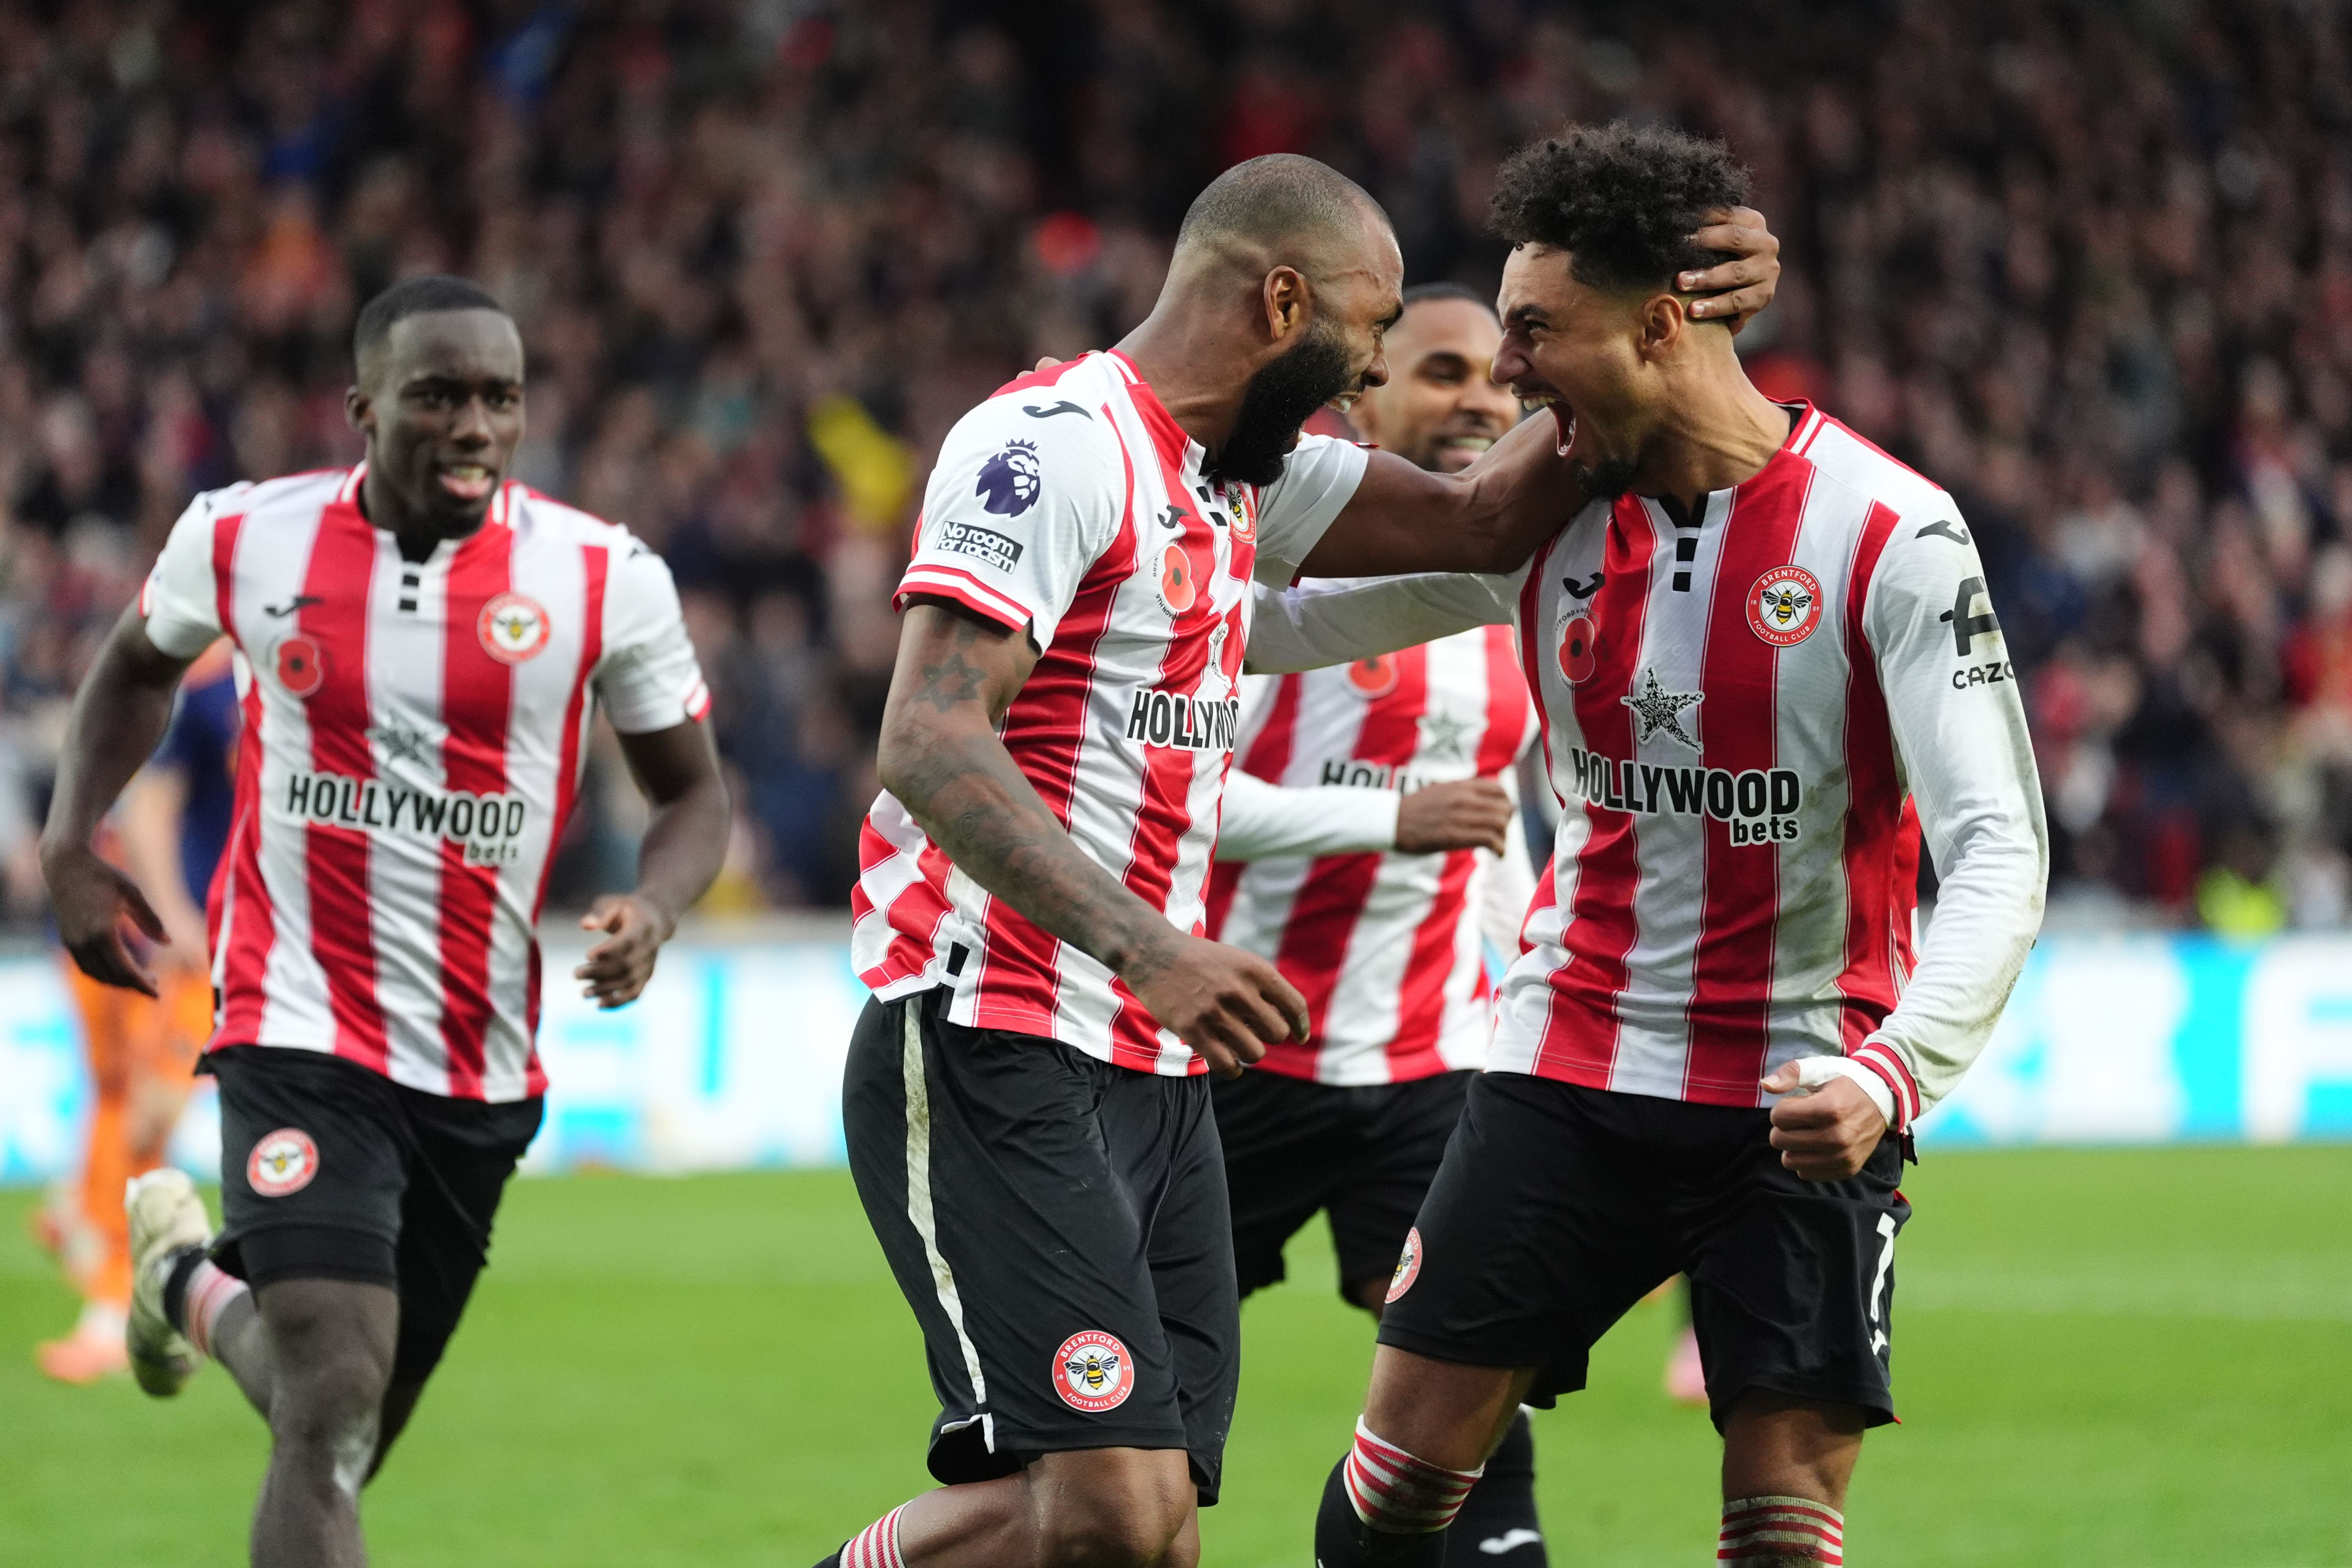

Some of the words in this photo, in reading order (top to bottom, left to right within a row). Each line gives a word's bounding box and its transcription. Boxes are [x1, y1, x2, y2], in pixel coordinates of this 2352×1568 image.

[943, 522, 965, 539] No
[965, 529, 1015, 557] room
[935, 535, 961, 550] for
[959, 541, 1015, 574] racism
[1761, 569, 1817, 591] BRENTFORD
[1155, 594, 1164, 608] 9TH
[1753, 620, 1789, 642] FOOTBALL
[1791, 625, 1810, 640] CLUB
[1953, 661, 2014, 690] CAZO
[1126, 691, 1239, 749] HOLLYWO
[1571, 748, 1800, 819] HOLLYWOOD
[287, 775, 524, 838] HOLLYWOOD
[1733, 817, 1798, 844] bets
[469, 841, 518, 860] bets
[1060, 1334, 1120, 1358] BRENTFORD
[1067, 1392, 1109, 1408] FOOTBALL
[1109, 1385, 1128, 1403] CLUB
